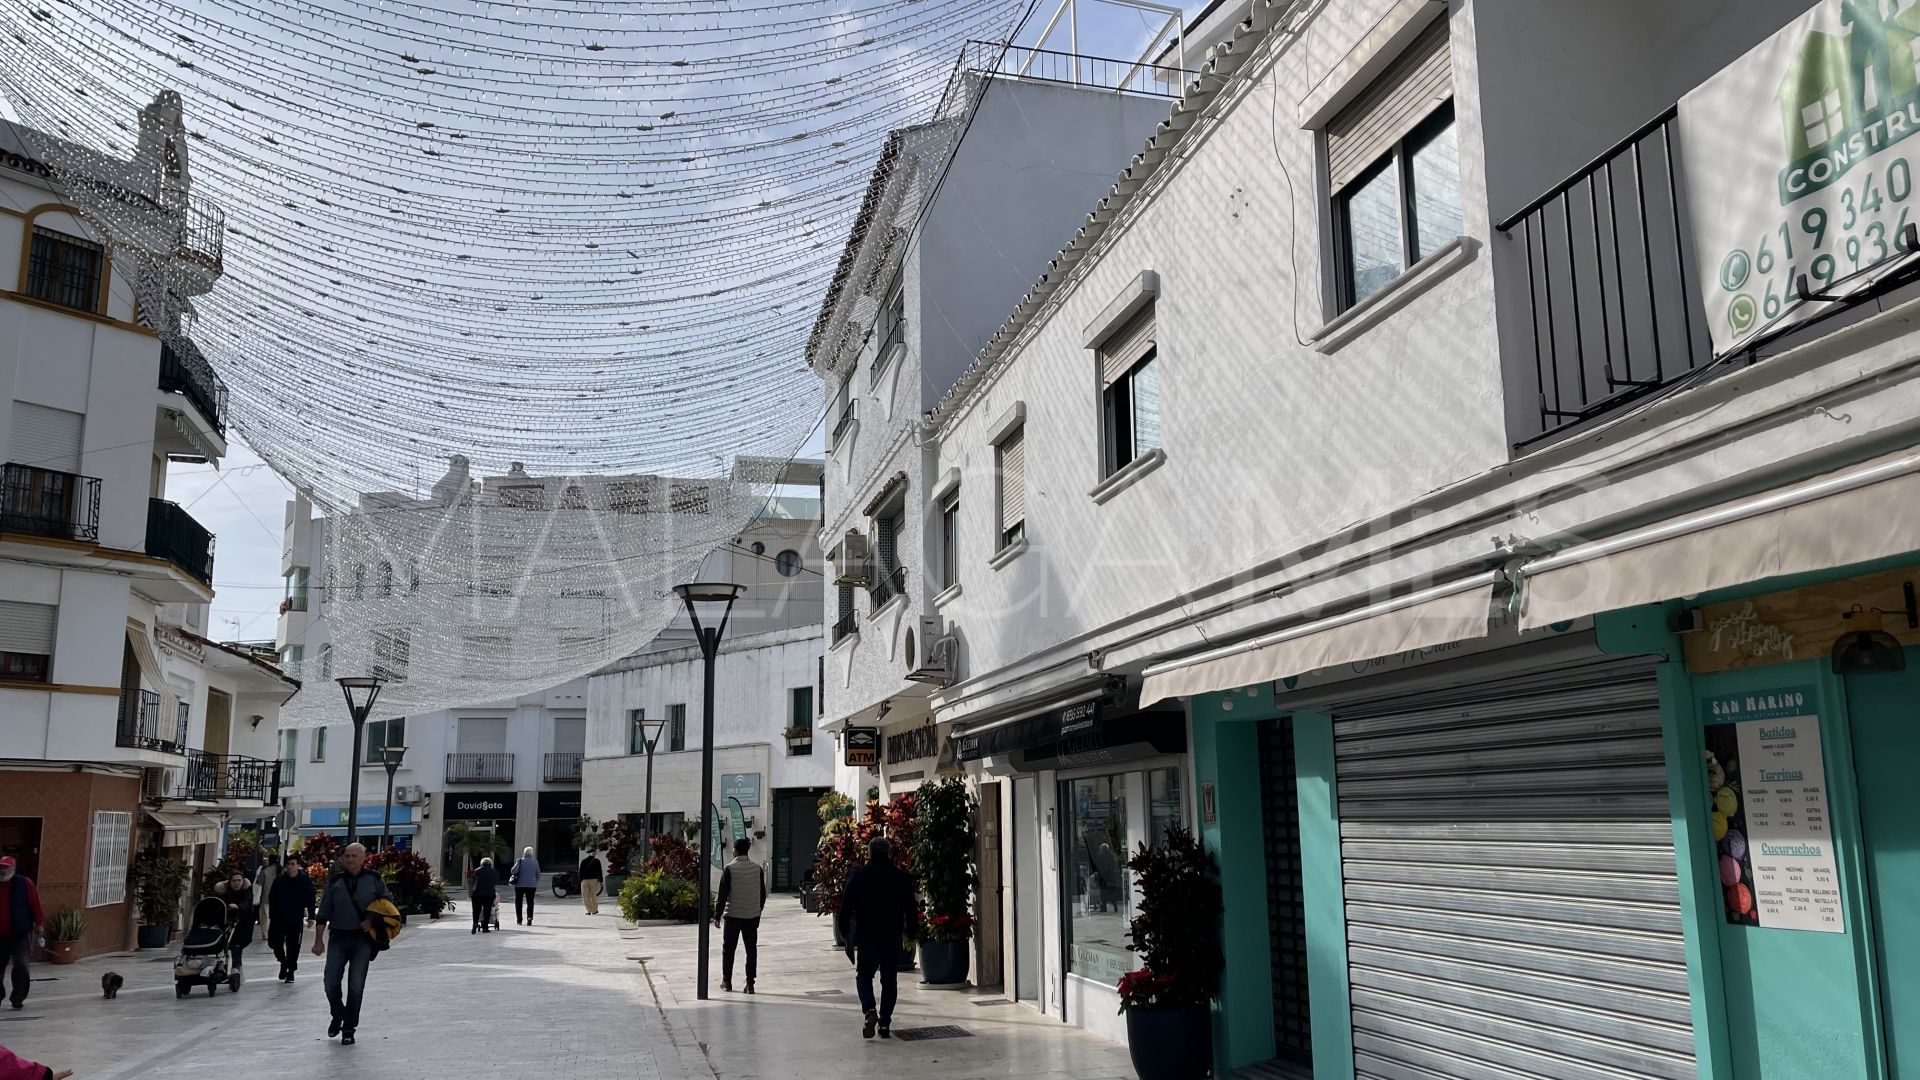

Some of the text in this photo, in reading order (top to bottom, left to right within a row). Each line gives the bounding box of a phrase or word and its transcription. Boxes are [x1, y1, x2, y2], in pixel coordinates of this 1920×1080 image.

[1756, 157, 1912, 275] 619 340
[1712, 699, 1740, 715] SAN
[1759, 727, 1797, 739] Batidos
[848, 753, 875, 763] ATM
[1759, 769, 1804, 781] Tarrinas
[1762, 842, 1822, 855] Cucuruchos
